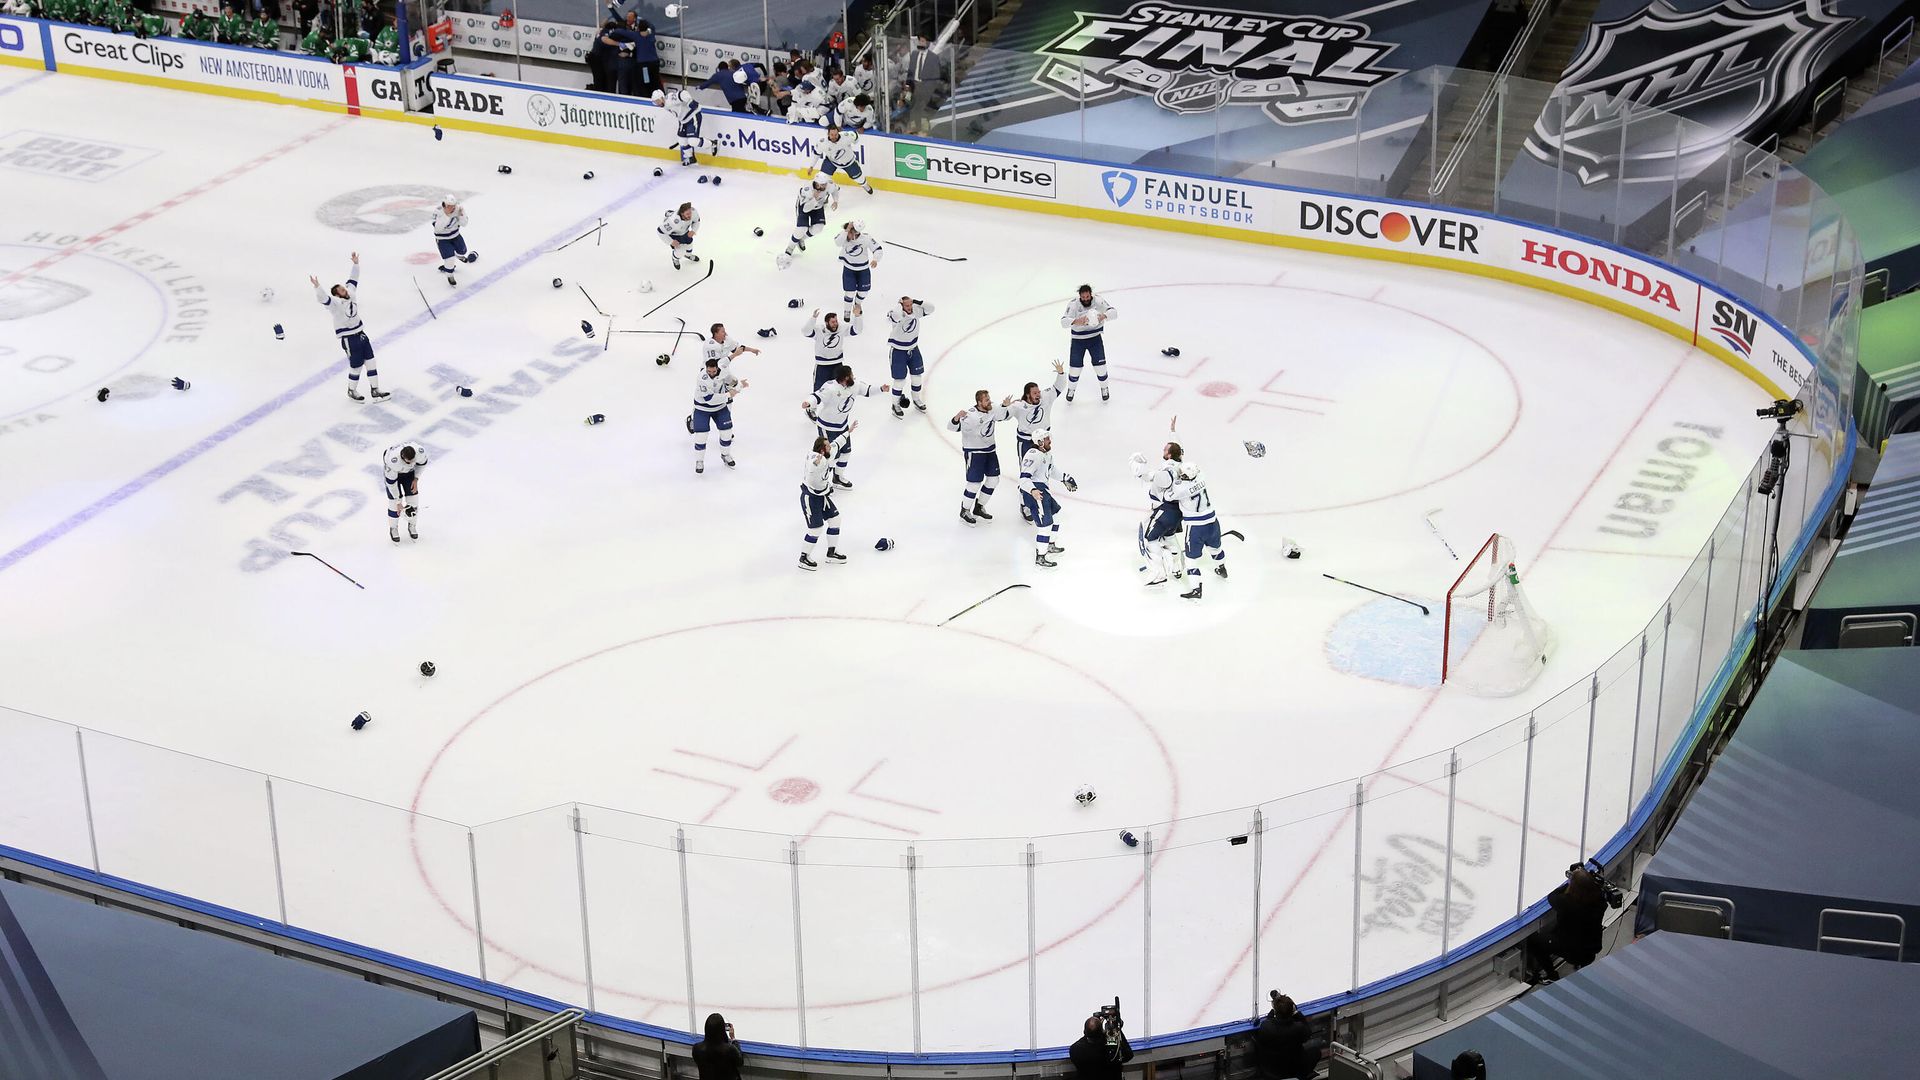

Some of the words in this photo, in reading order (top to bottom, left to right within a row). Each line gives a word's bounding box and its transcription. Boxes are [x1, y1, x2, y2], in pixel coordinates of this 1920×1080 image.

[1130, 6, 1281, 34] STANLEY
[1283, 21, 1360, 42] CUP
[64, 32, 129, 61] Great
[132, 42, 185, 73] Clips
[1055, 19, 1383, 83] FINAL
[200, 55, 223, 76] NEW
[226, 60, 294, 86] AMSTERDAM
[297, 68, 330, 91] VODKA
[1126, 66, 1162, 83] 20
[1168, 81, 1227, 103] NHL
[1240, 83, 1282, 94] 20
[1565, 41, 1765, 128] NHL
[16, 136, 125, 161] BUD
[738, 129, 865, 165] MassMual
[904, 153, 1052, 187] enterprise
[1145, 177, 1253, 210] FANDUEL
[1145, 199, 1253, 224] SPORTSBOOK
[1300, 201, 1479, 255] DISCOVER
[23, 231, 181, 273] HOCKEY
[164, 274, 210, 344] LEAGUE
[1521, 239, 1681, 312] HONDA
[1712, 300, 1757, 346] SN
[1772, 350, 1788, 373] THE
[216, 362, 480, 504] FINAL
[1023, 458, 1034, 467] 27
[1596, 421, 1725, 539] roman
[1191, 488, 1211, 512] 71
[238, 488, 369, 574] CUP
